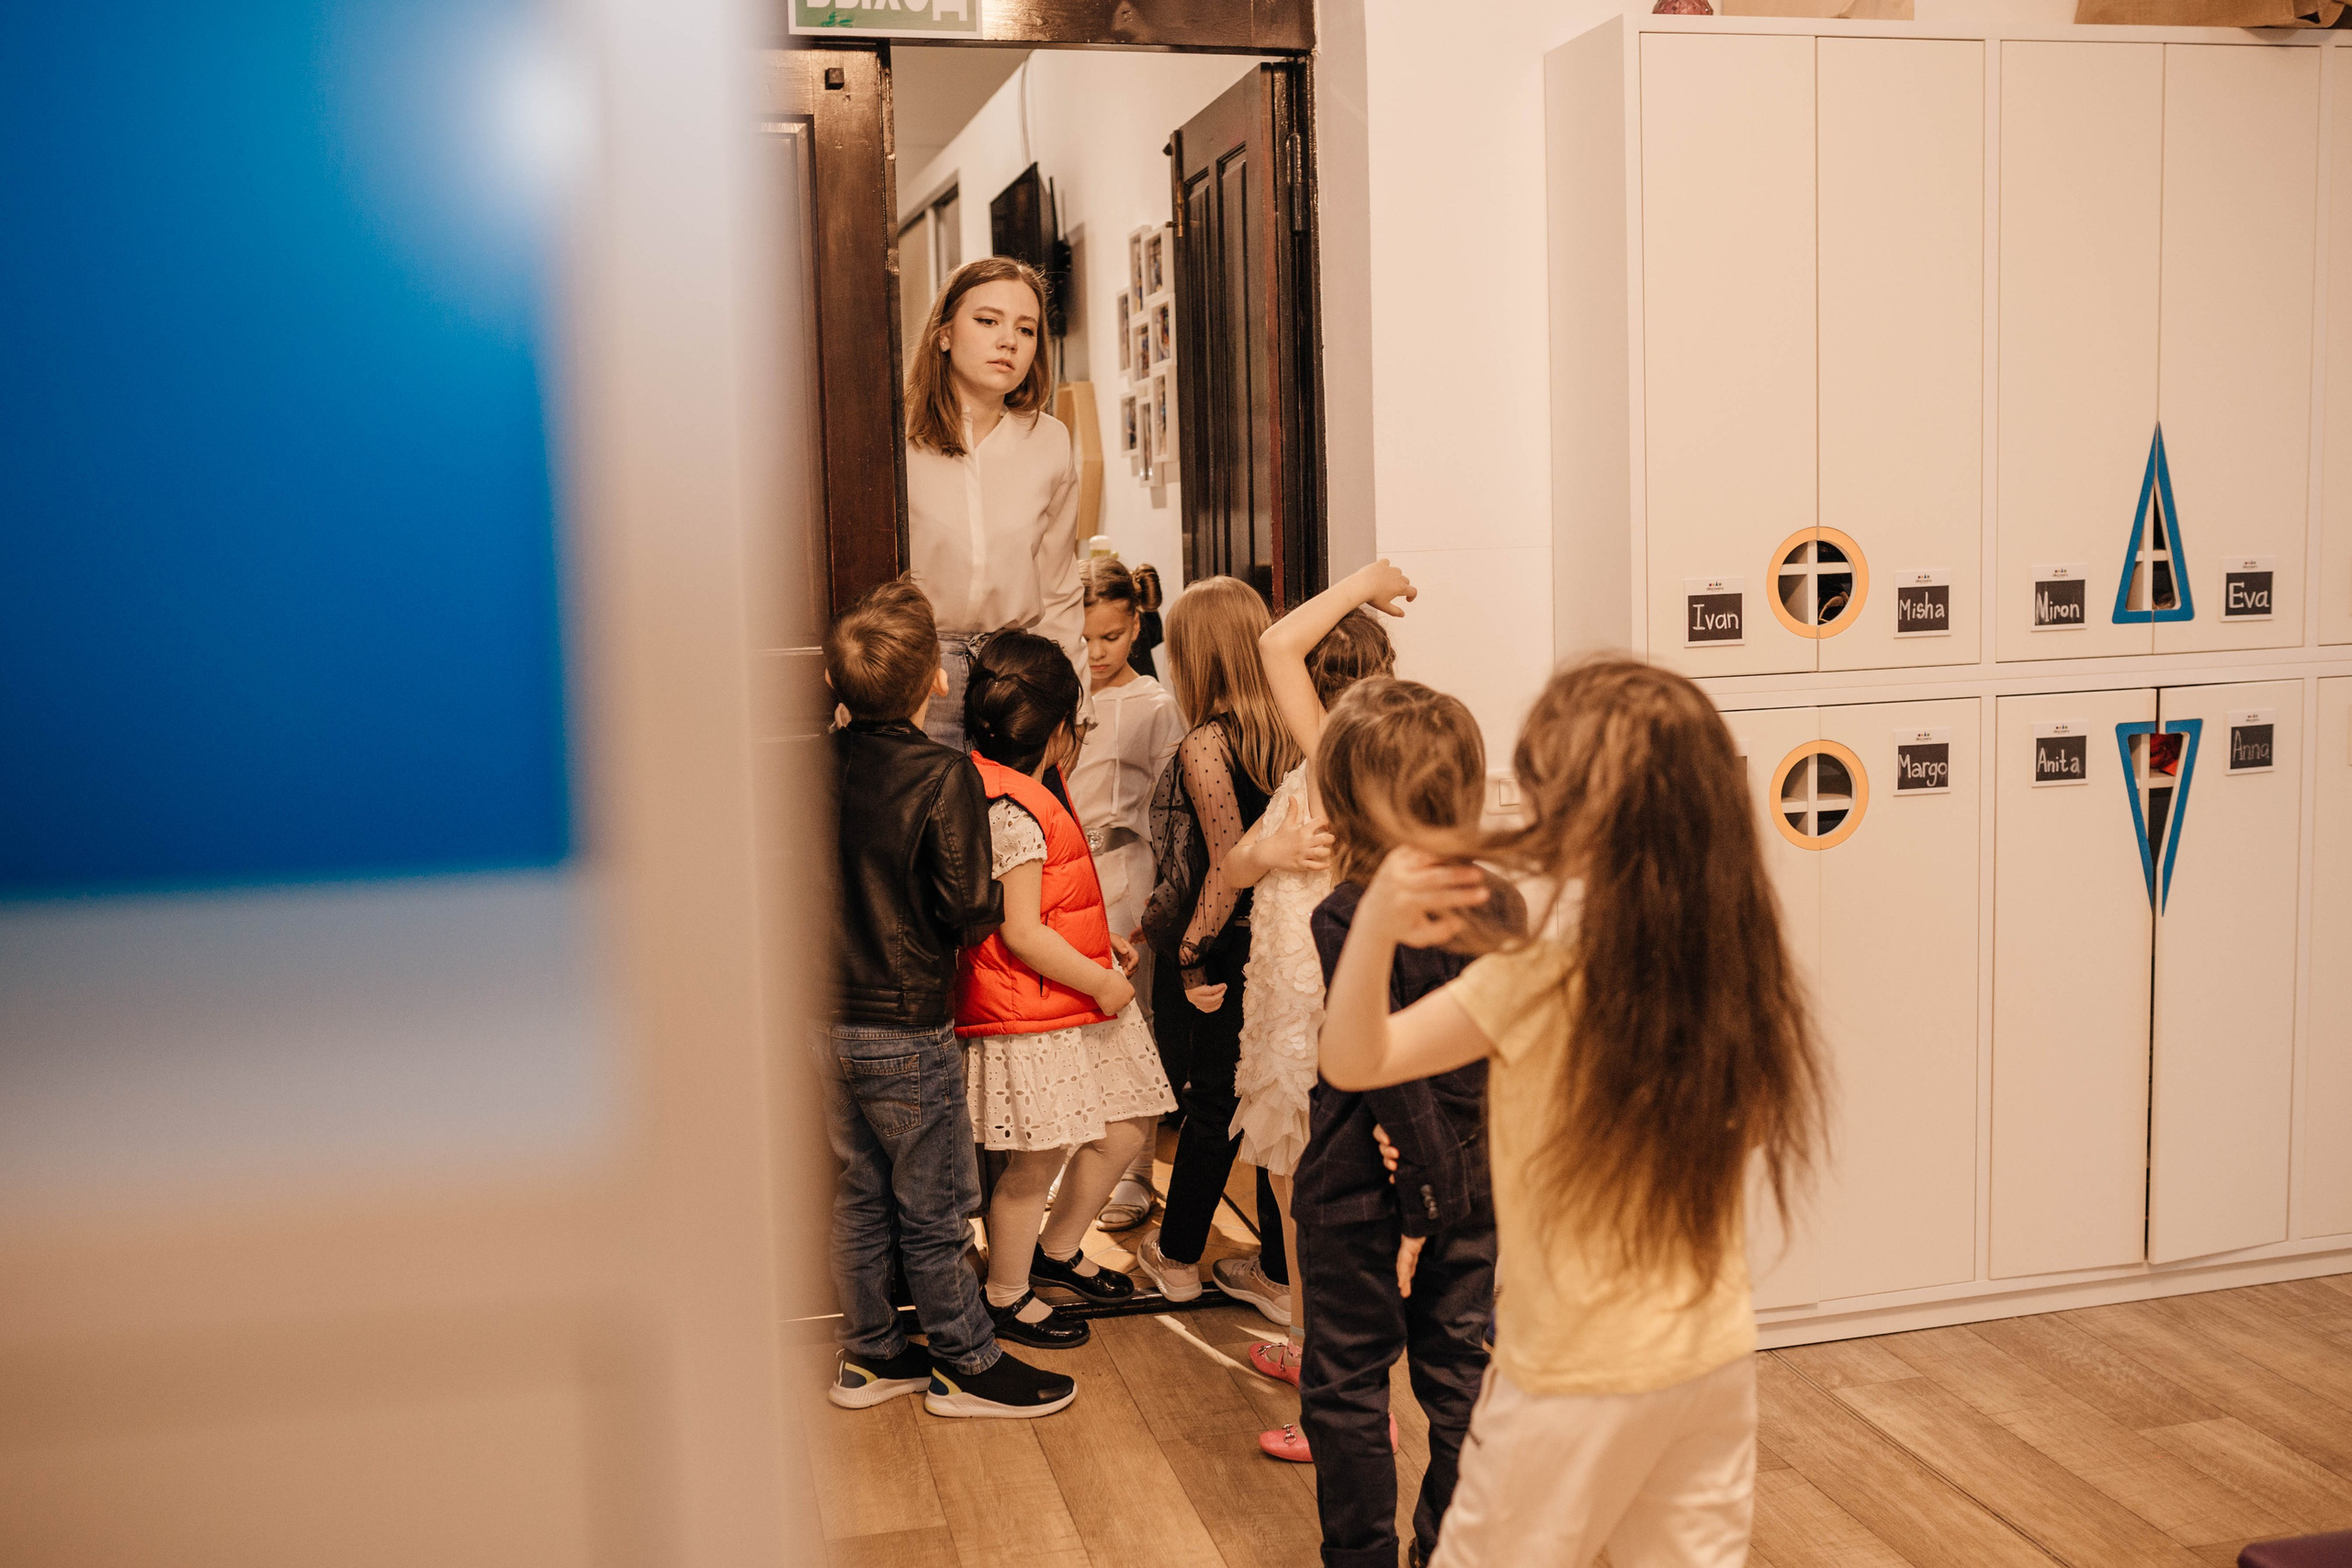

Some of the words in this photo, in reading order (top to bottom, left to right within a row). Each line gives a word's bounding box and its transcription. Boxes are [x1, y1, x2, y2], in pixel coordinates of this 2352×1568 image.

[1898, 591, 1945, 621] Misha
[2035, 591, 2080, 624] Miron
[2228, 581, 2270, 609] Eva
[1692, 604, 1739, 631] Ivan
[2037, 747, 2081, 773] Anita
[2233, 729, 2270, 761] Anna
[1898, 753, 1948, 787] Margo
